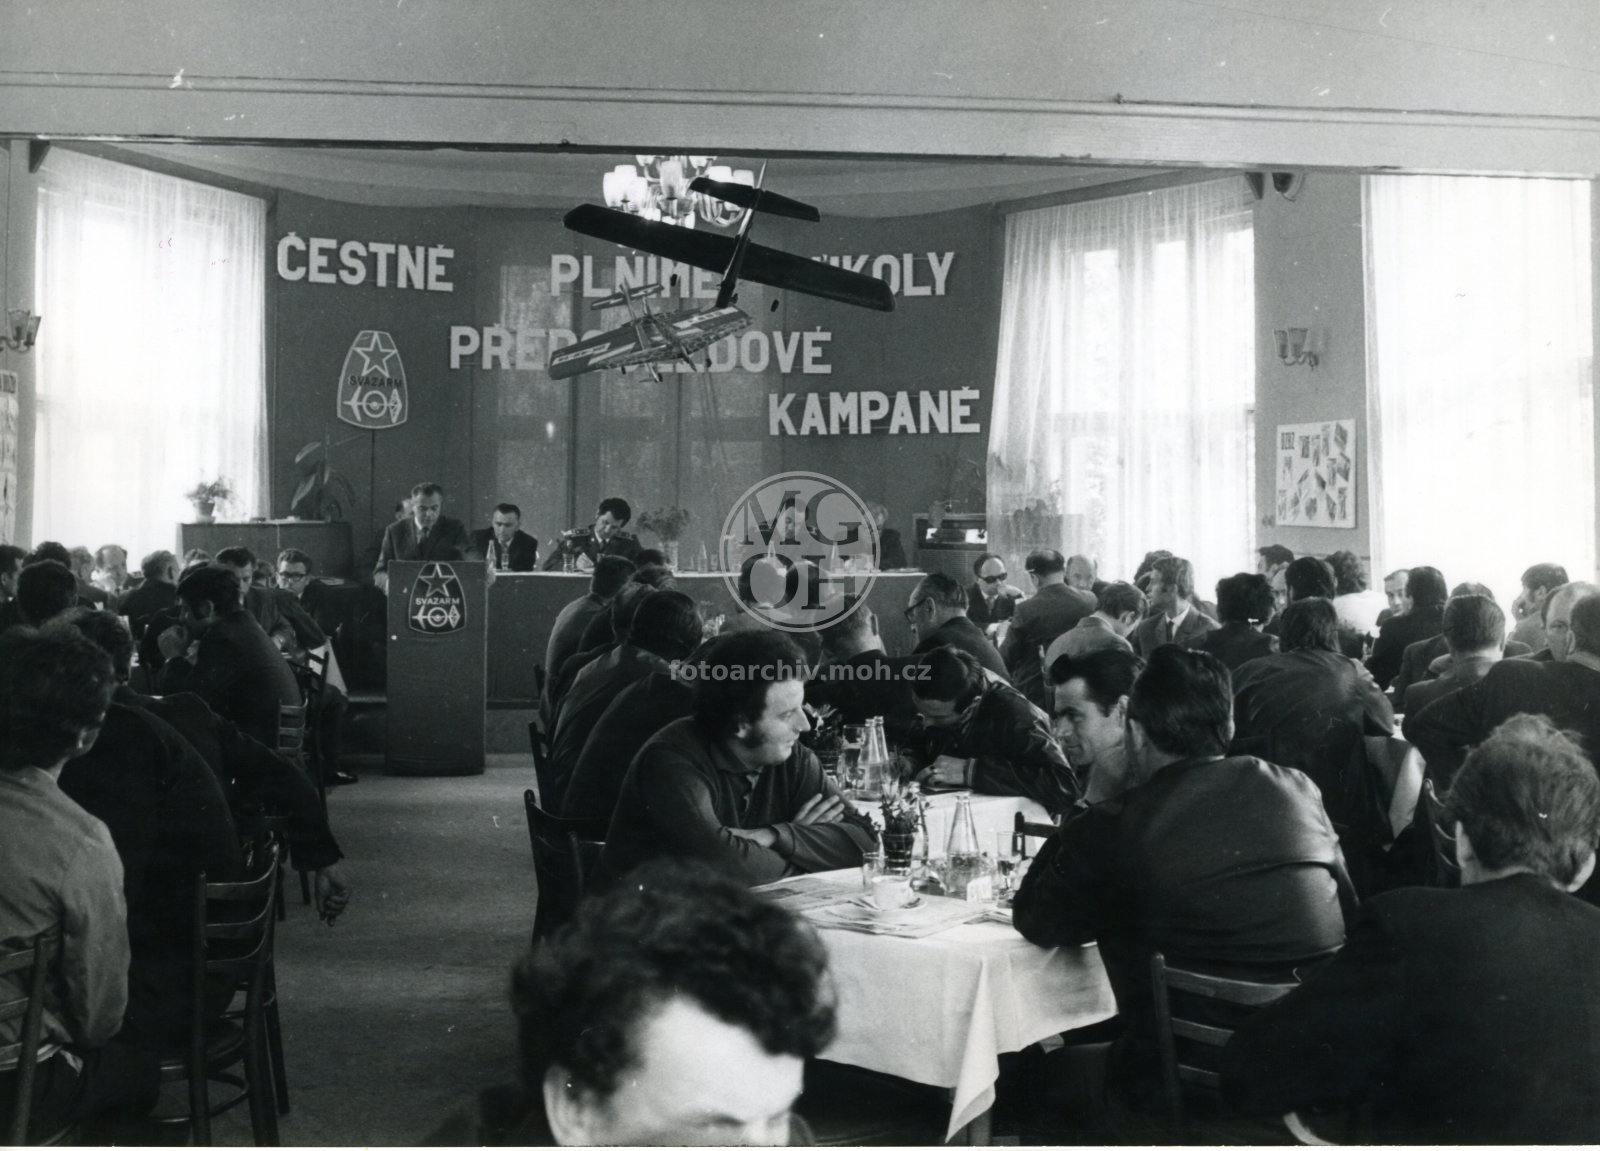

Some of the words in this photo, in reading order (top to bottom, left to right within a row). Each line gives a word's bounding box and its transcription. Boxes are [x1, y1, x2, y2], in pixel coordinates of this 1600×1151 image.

[277, 231, 454, 292] ČESTNĚ
[812, 252, 955, 297] OLY
[349, 375, 402, 388] SVAZARM
[768, 386, 981, 435] KAMPANĚ
[415, 597, 460, 606] SVAZARM
